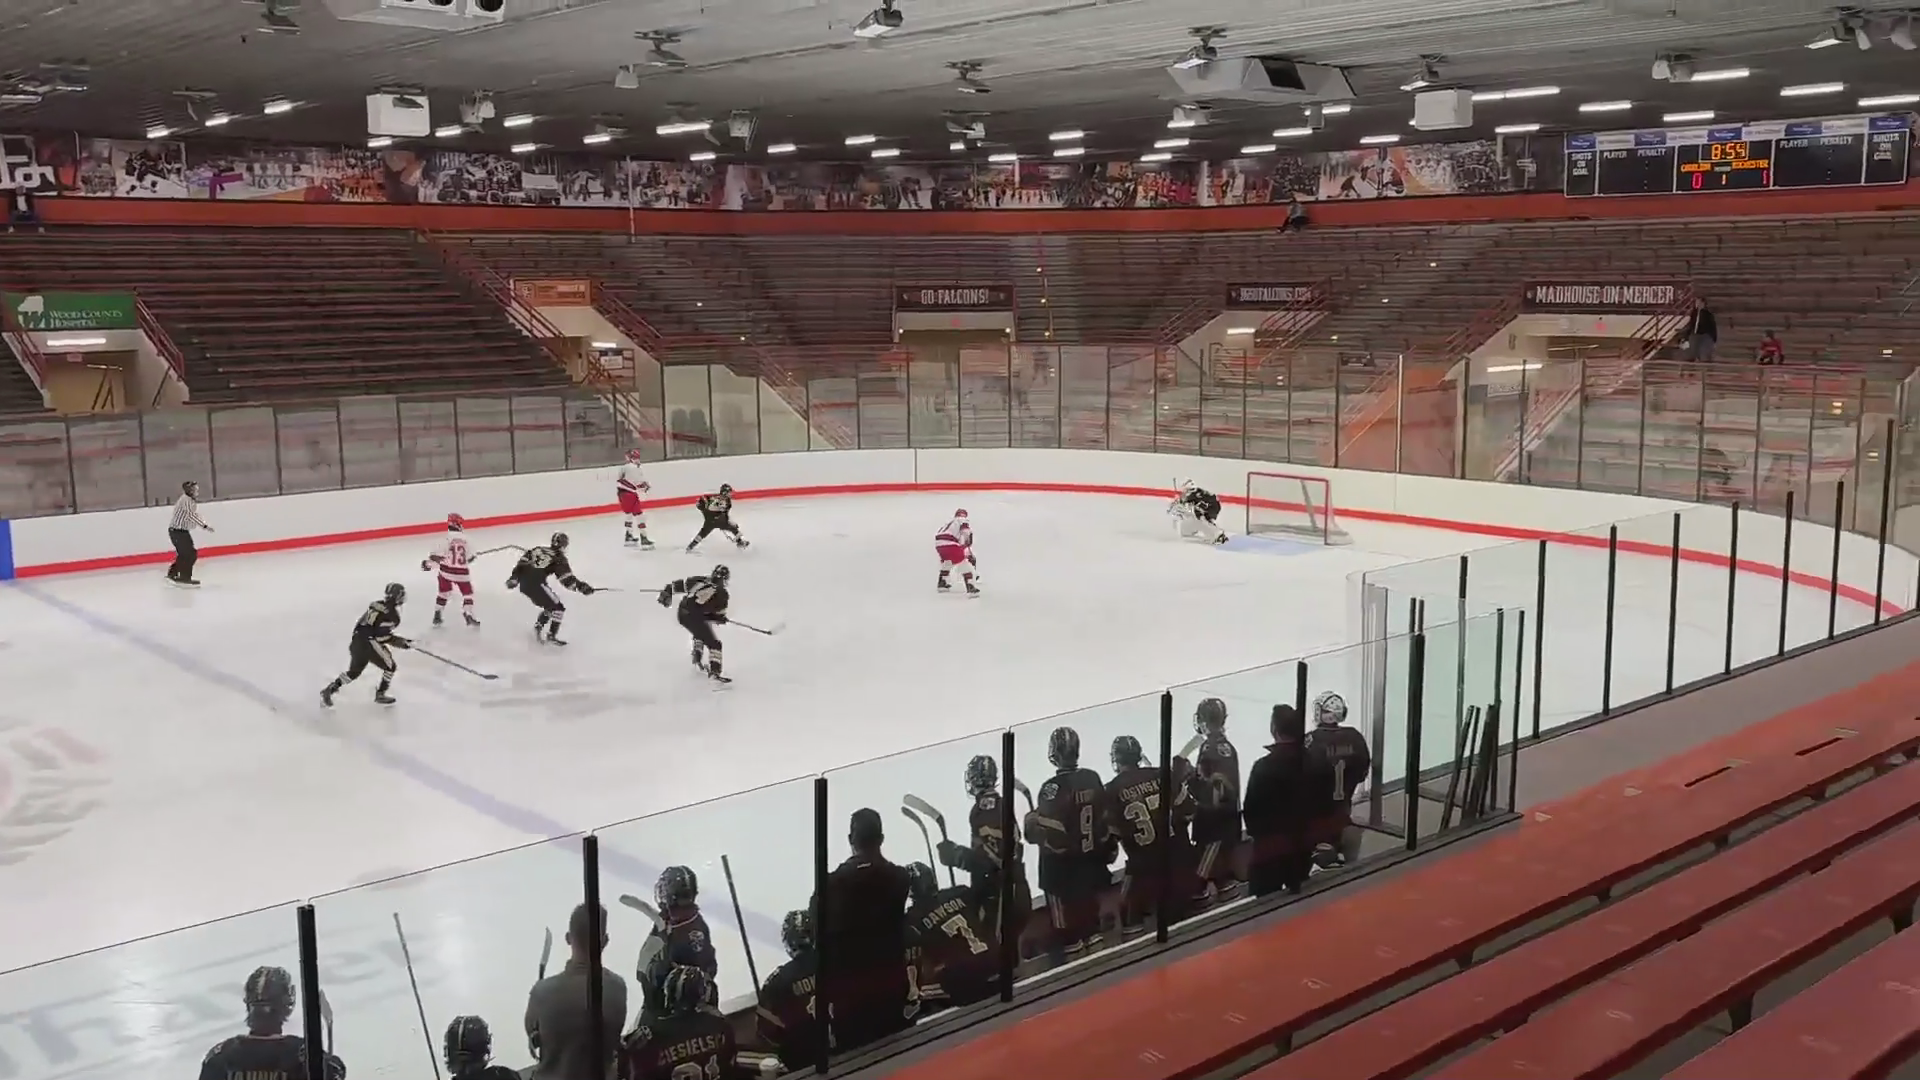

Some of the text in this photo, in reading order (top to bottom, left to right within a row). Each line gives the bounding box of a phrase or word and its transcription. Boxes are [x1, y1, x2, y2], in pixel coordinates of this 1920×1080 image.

[1780, 139, 1809, 148] PLAYER
[1603, 151, 1628, 159] PLAYER
[921, 288, 989, 305] GO FALCONS!
[1535, 285, 1675, 304] MADHOUSE ON MERCER
[49, 309, 80, 319] WOOD
[50, 319, 98, 329] HOSPITAL
[449, 544, 467, 566] 13
[1332, 759, 1346, 801] 1
[1079, 804, 1095, 853] 9
[921, 897, 967, 930] DAWSON
[940, 913, 989, 955] 7
